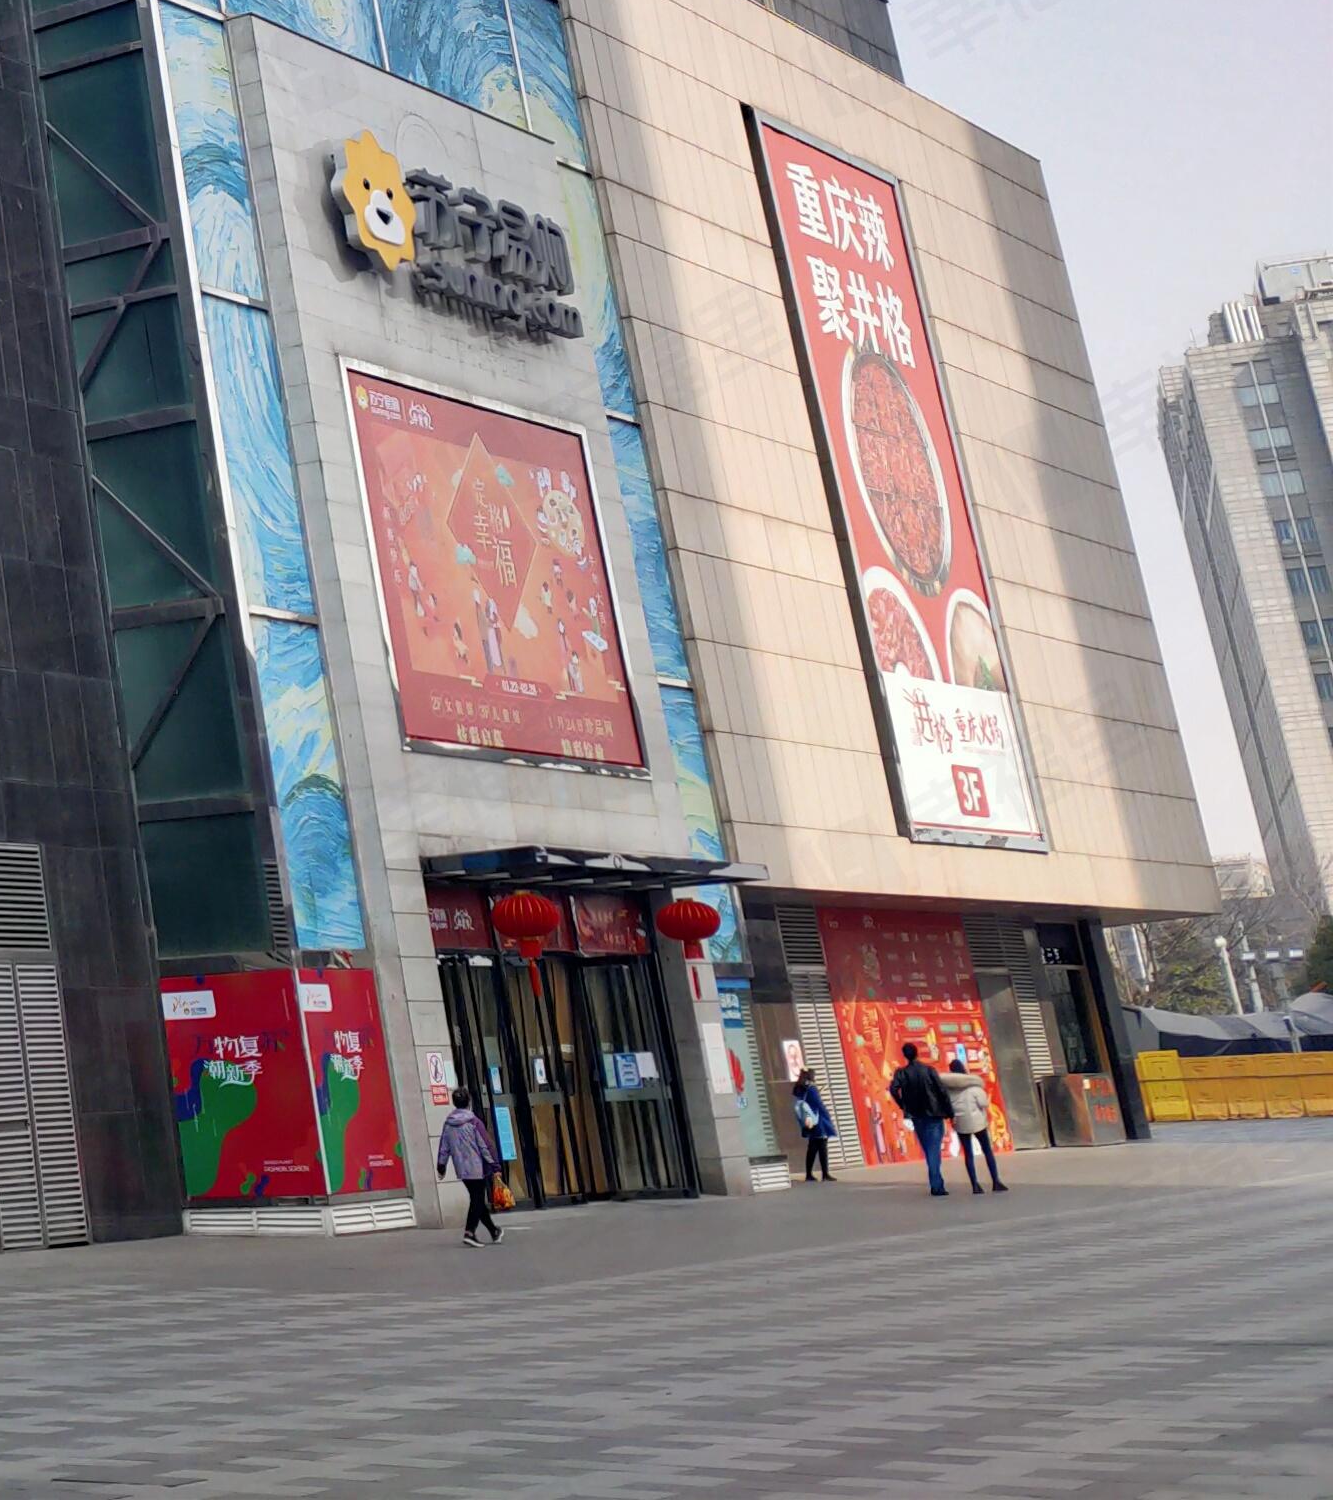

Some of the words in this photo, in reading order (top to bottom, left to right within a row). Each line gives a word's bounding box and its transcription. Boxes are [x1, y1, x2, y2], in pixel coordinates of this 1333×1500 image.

[786, 160, 895, 272] 重庆辣
[806, 253, 917, 369] 聚井格
[957, 771, 982, 813] 3F
